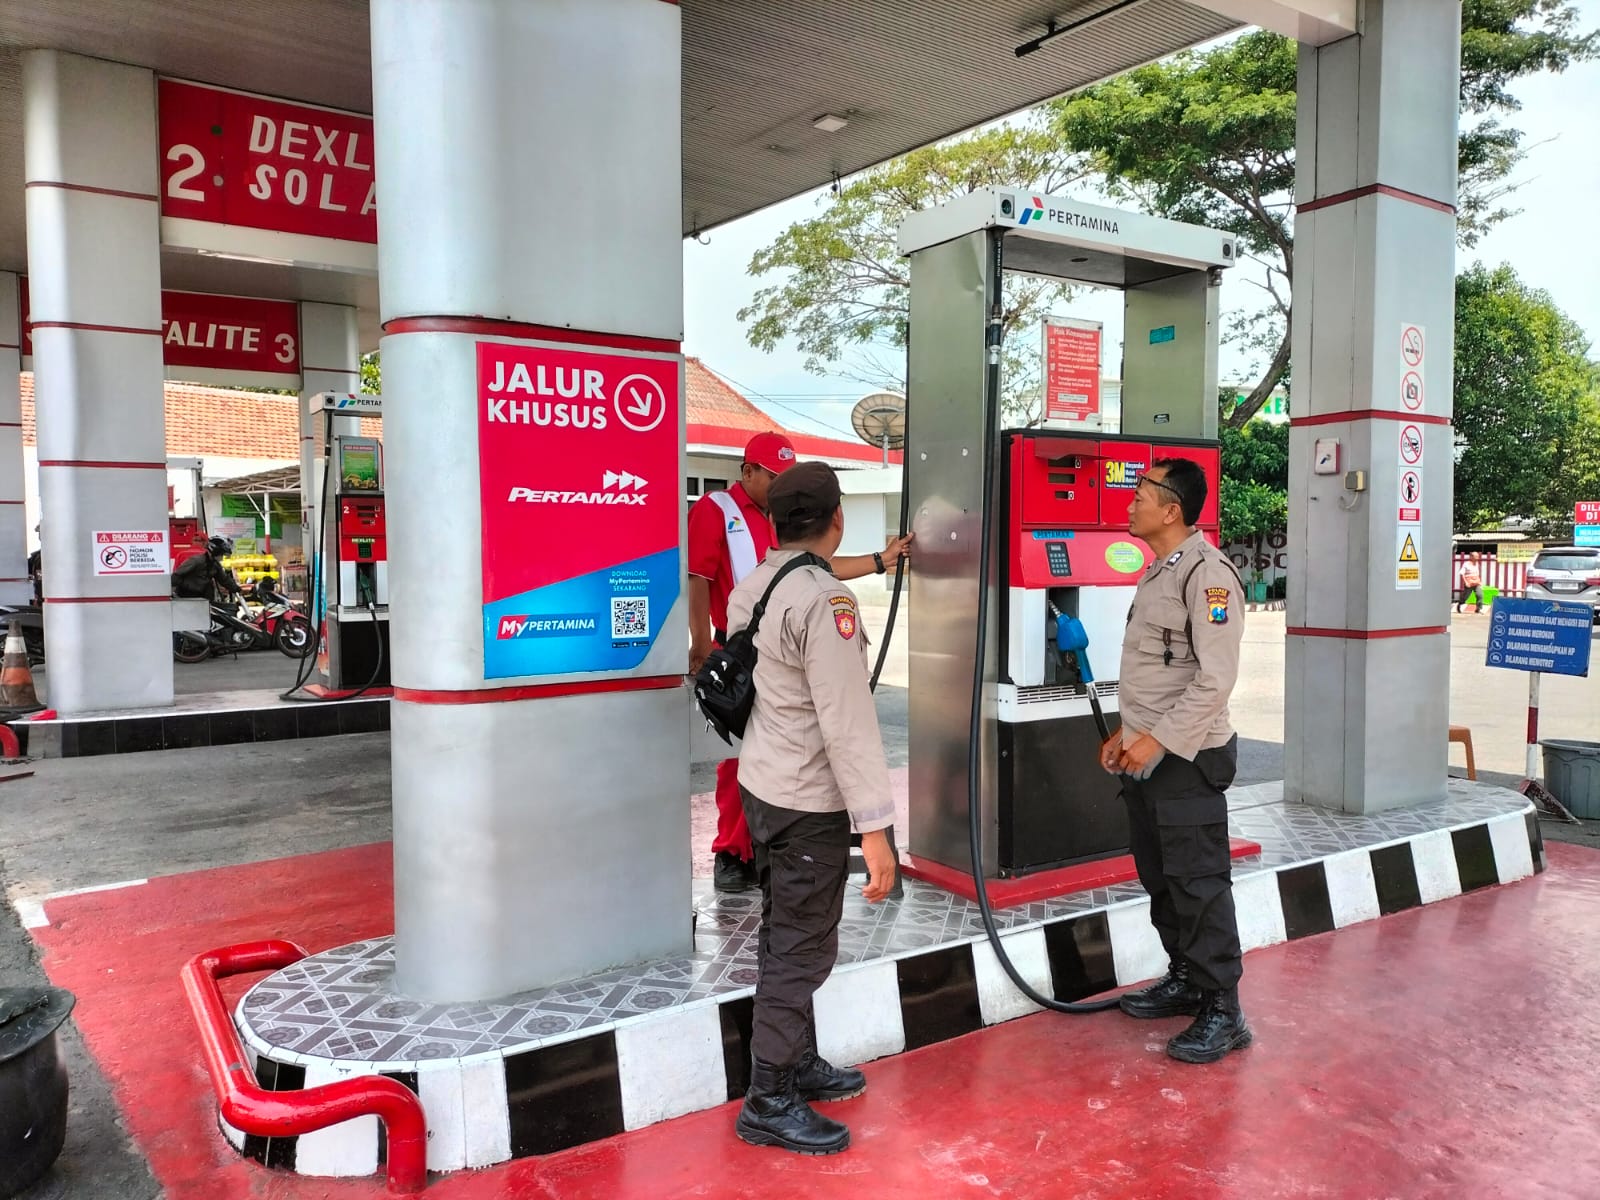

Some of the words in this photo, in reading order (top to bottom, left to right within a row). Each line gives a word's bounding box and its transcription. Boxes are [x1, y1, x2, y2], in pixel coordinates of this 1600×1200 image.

[249, 115, 370, 171] DEXL
[167, 144, 206, 202] 2
[1049, 209, 1119, 235] PERTAMINA
[274, 333, 296, 364] 3
[488, 361, 606, 400] JALUR
[488, 398, 607, 430] KHUSUS
[1105, 461, 1125, 483] 3M
[508, 487, 649, 505] PERTAMAX
[343, 506, 350, 514] 2
[1586, 512, 1598, 520] DI
[1530, 615, 1545, 625] MESIN
[1508, 627, 1531, 638] DILARANG
[1506, 641, 1530, 652] DILARANG
[1505, 654, 1529, 665] DILARANG
